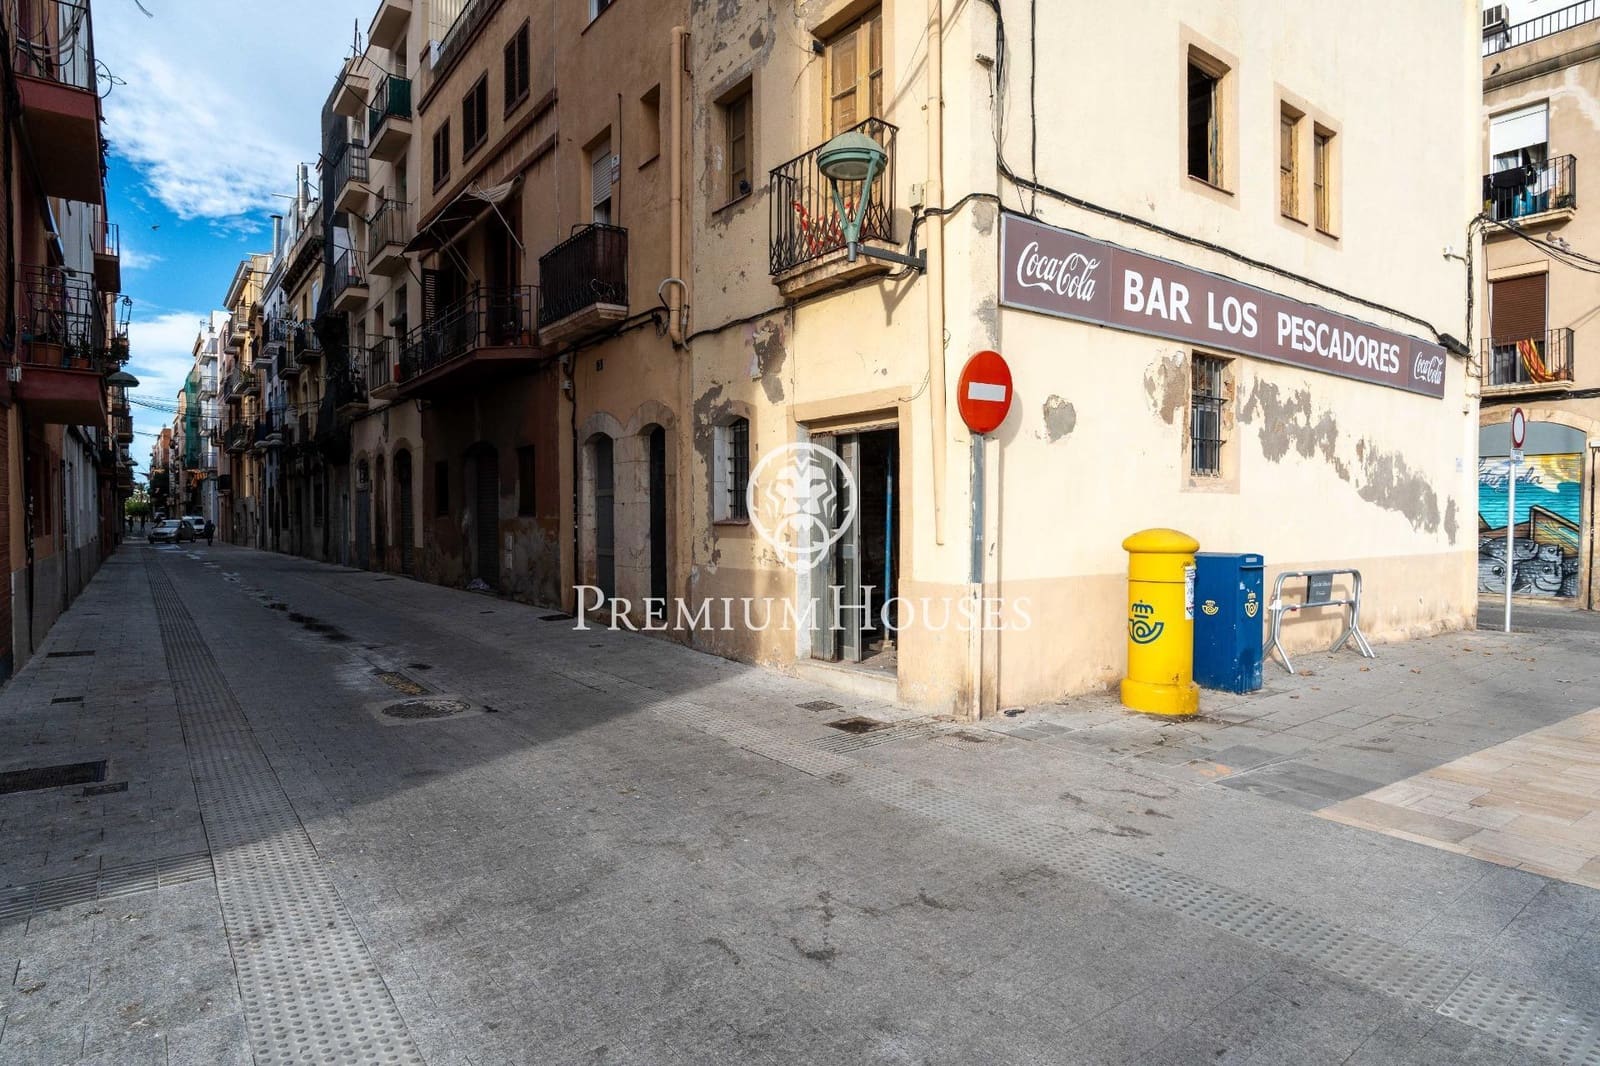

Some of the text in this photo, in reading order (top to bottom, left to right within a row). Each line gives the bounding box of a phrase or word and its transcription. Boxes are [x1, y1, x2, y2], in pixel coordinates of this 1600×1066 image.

[1123, 269, 1400, 374] BAR LOS PESCADORES
